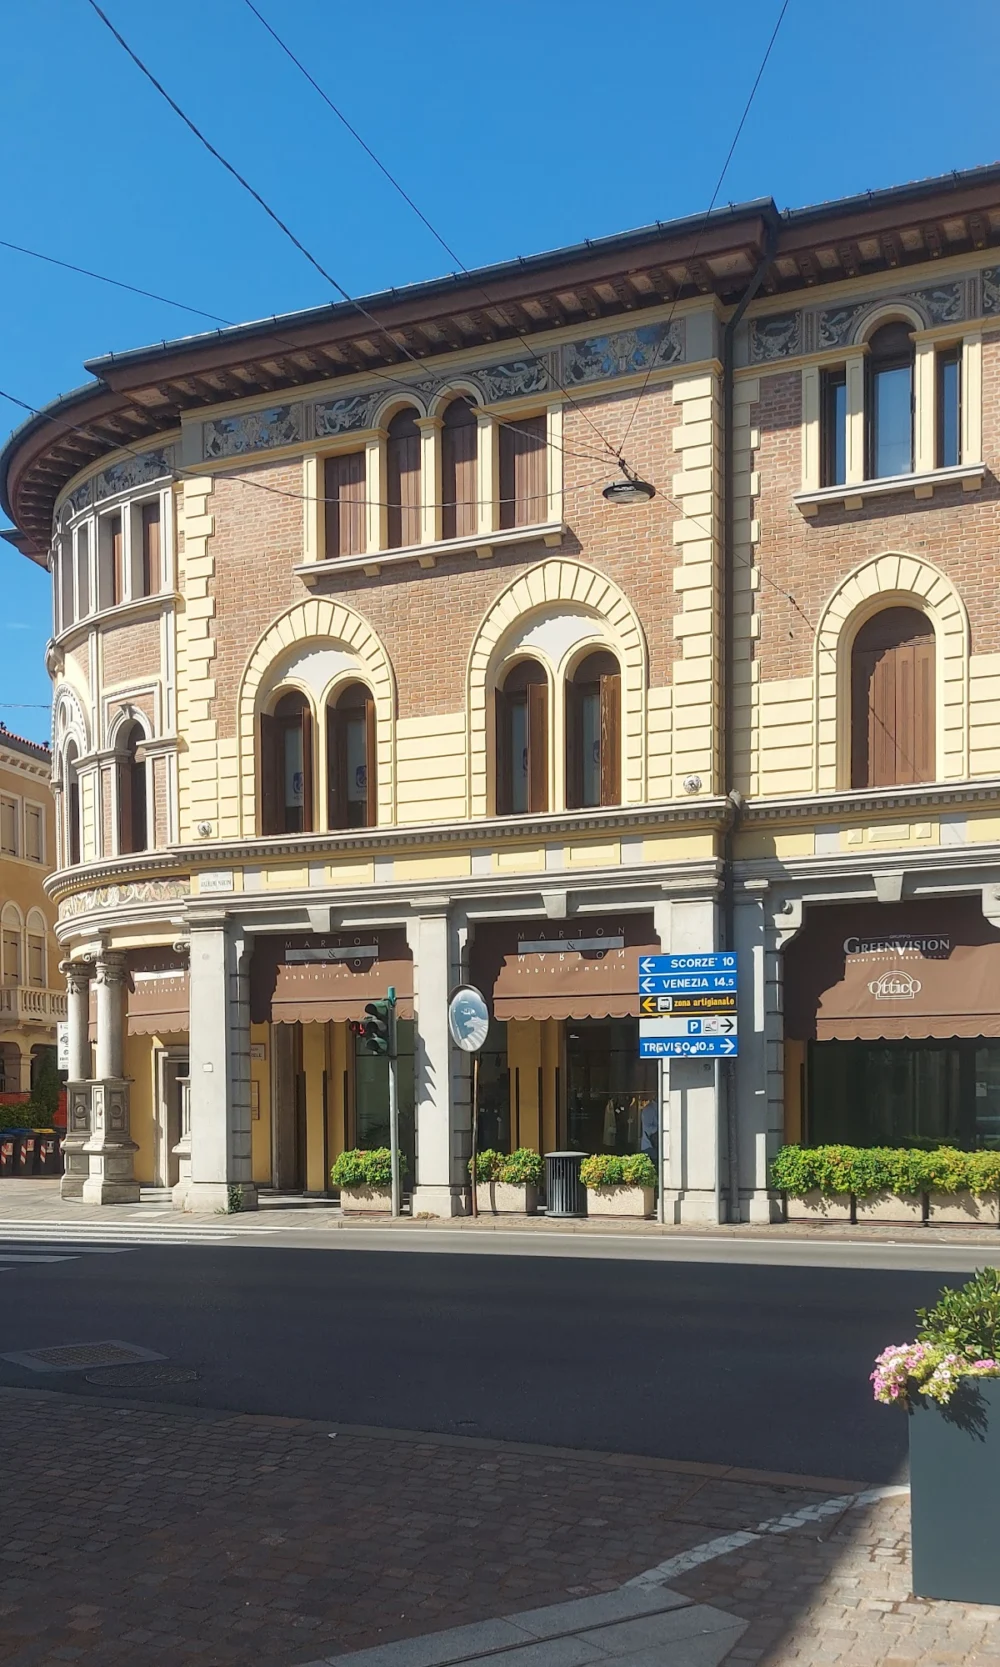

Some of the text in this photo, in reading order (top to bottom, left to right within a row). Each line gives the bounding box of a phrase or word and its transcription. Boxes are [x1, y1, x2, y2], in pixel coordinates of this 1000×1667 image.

[517, 927, 625, 940] MARTON
[285, 937, 378, 948] MARTON
[566, 940, 576, 950] &
[327, 948, 336, 959] &
[722, 956, 735, 967] 10
[662, 977, 735, 989] VENEZIA 14.5
[693, 996, 735, 1007] artigianale
[690, 1022, 699, 1032] P
[643, 1041, 715, 1053] TREVISO 10.5
